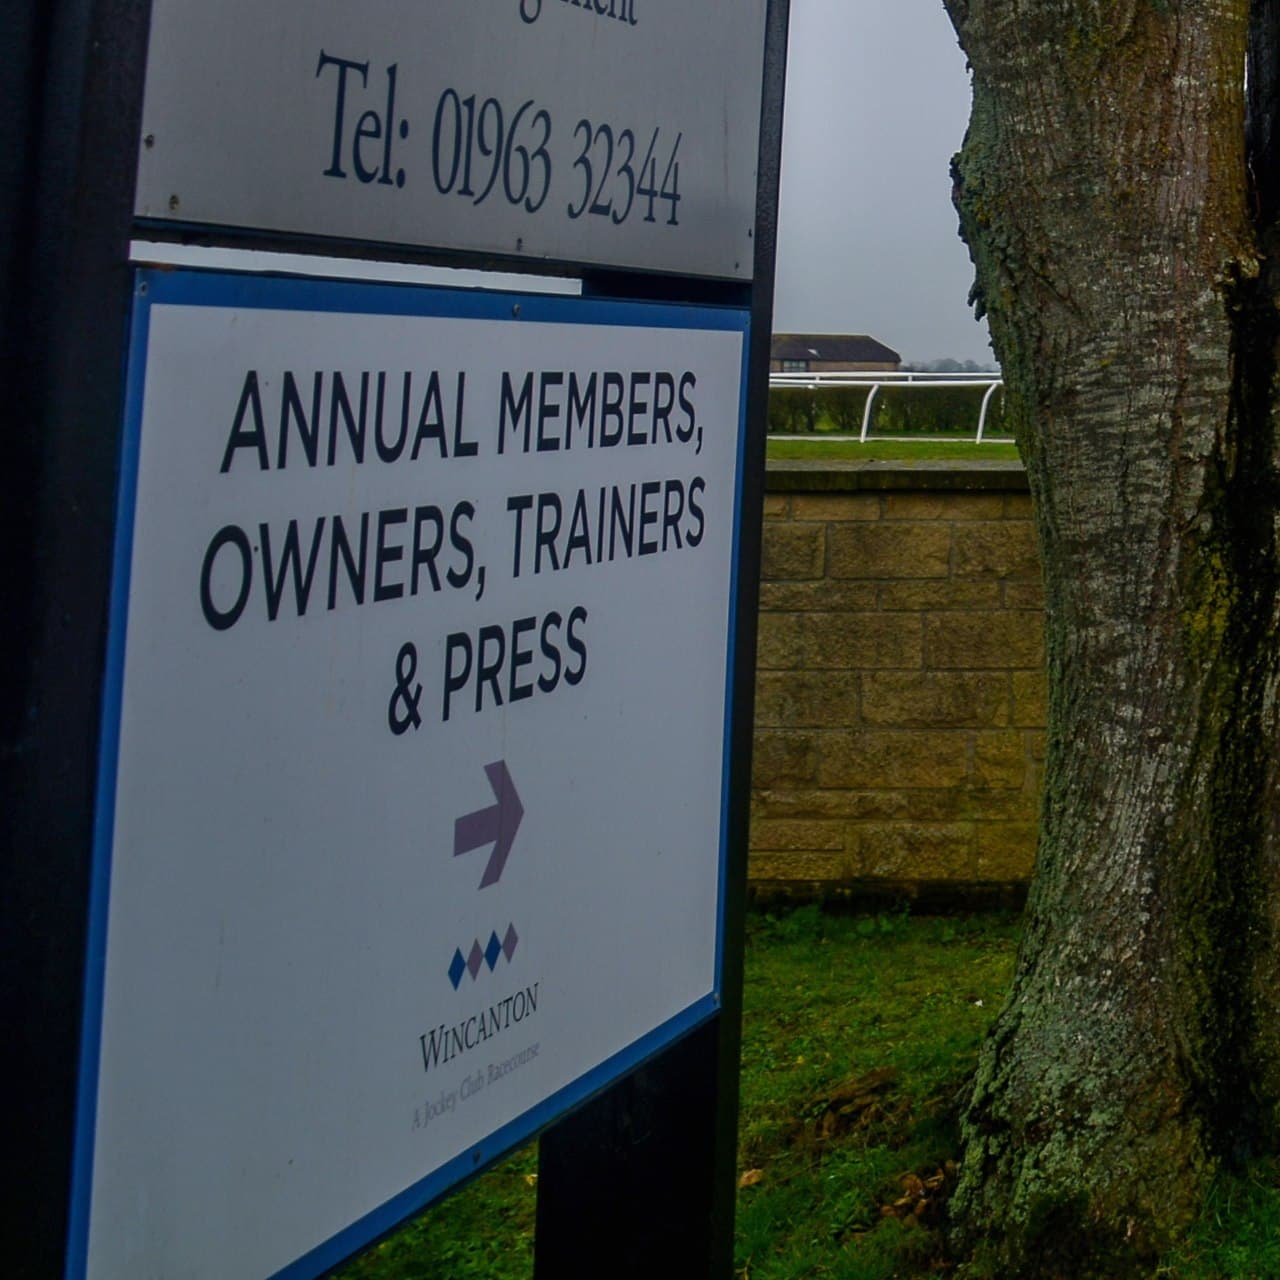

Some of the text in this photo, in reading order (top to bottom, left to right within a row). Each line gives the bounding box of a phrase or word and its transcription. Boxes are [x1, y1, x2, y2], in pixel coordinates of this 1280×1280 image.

[316, 49, 682, 225] Tel: 01963 32344
[220, 369, 704, 474] ANNUAL MEMBERS,
[200, 477, 706, 632] OWNERS, TRAINERS
[388, 605, 588, 736] & PRESS
[419, 983, 540, 1072] WINCANTON
[422, 1090, 457, 1129] Jockey
[460, 1069, 484, 1103] Club
[488, 1042, 541, 1086] Racecourse
